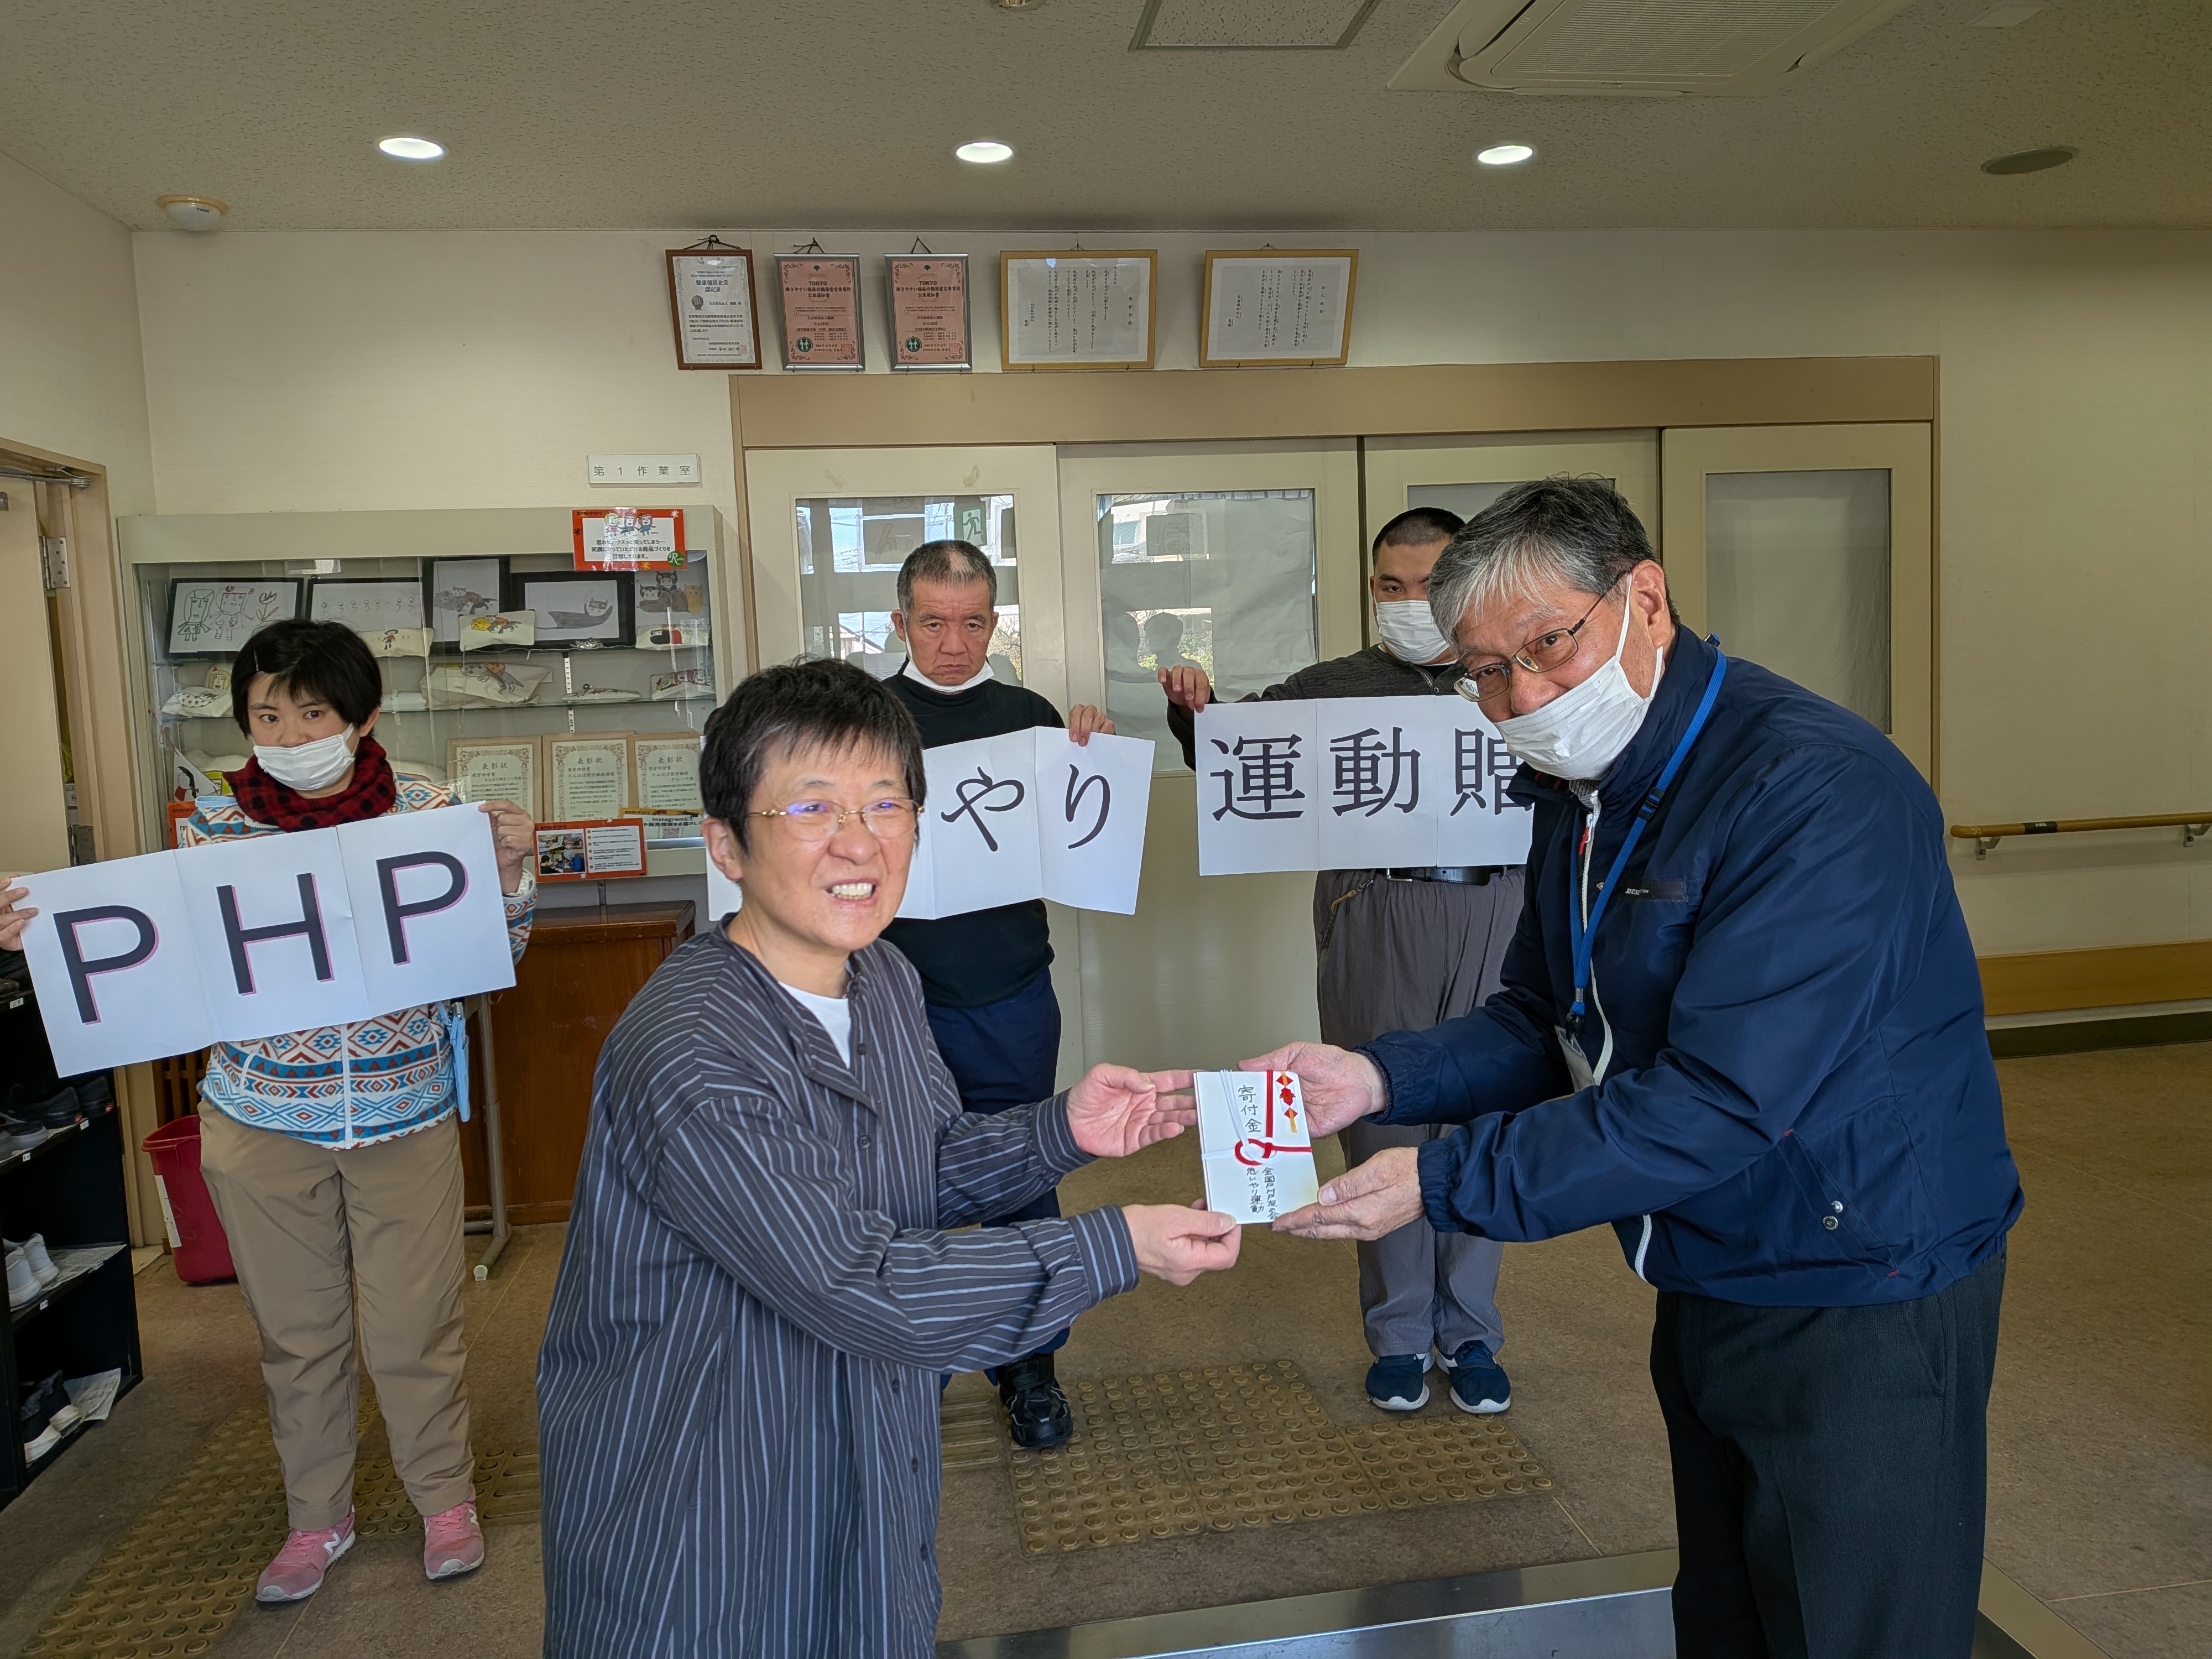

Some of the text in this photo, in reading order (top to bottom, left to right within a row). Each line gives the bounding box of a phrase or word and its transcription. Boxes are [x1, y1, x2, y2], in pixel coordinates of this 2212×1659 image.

[941, 763, 1112, 853] やり
[53, 851, 469, 1025] PHP
[1238, 1084, 1262, 1133] 寄付金
[1246, 1166, 1265, 1214] 思いやり運動
